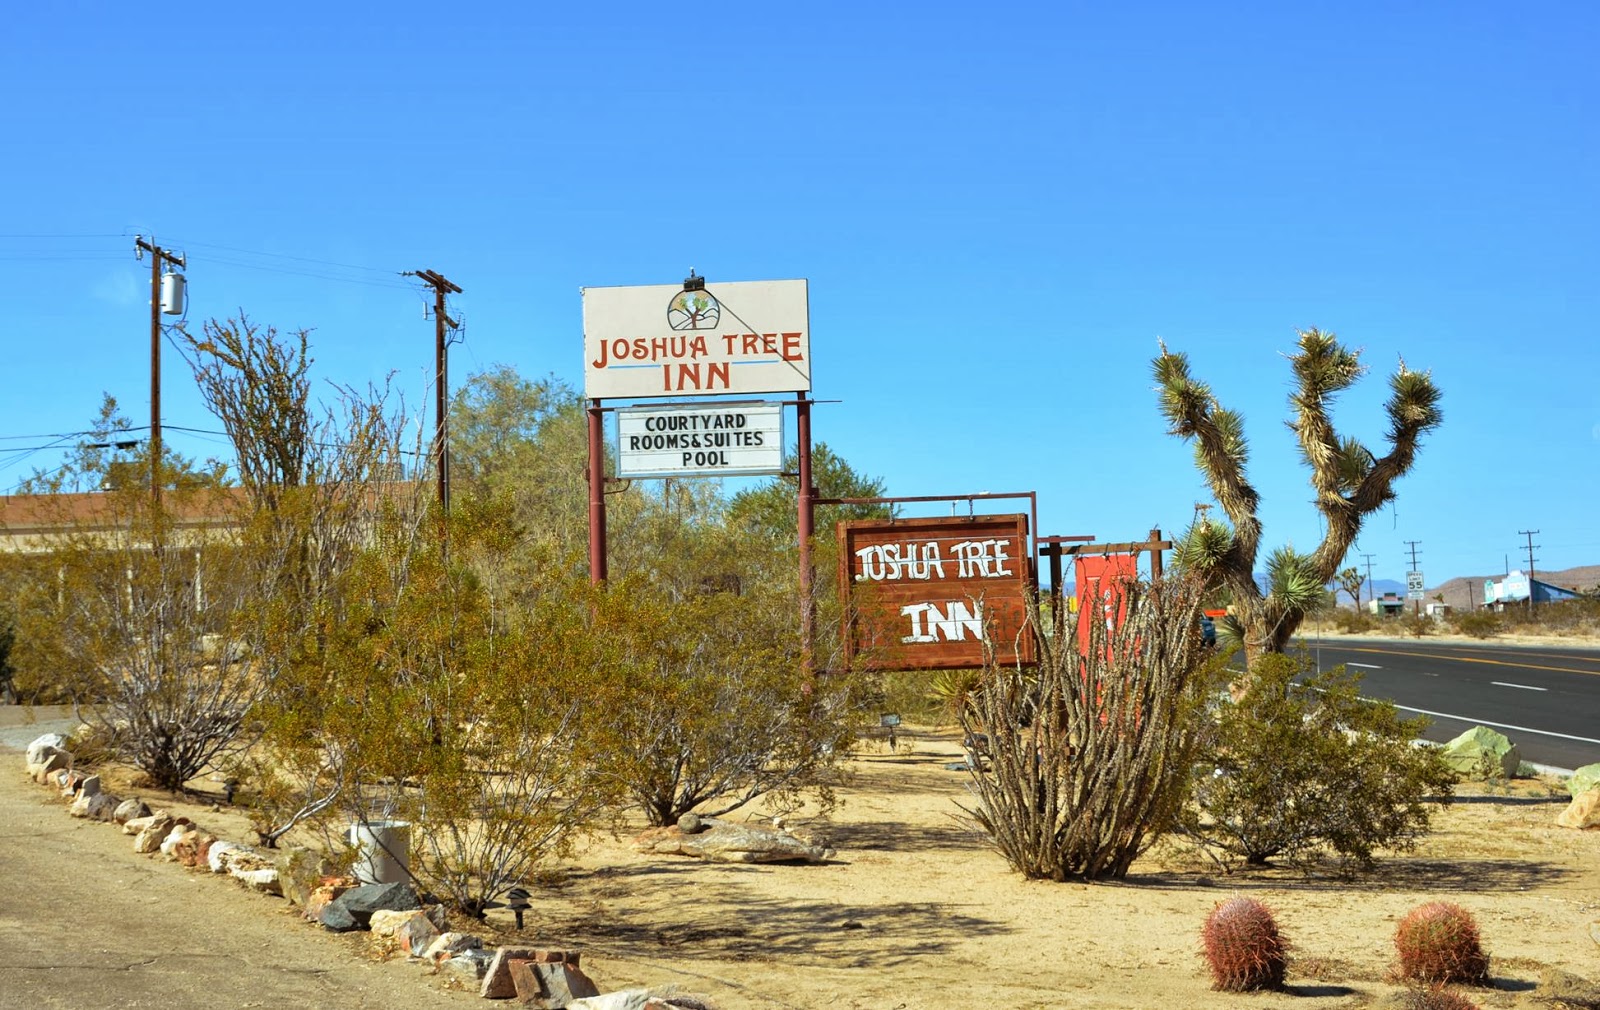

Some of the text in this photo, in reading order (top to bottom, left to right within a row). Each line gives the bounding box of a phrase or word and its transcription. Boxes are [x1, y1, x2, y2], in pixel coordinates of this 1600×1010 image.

[592, 332, 803, 369] JOSHUA TREE
[663, 362, 730, 391] INN
[645, 413, 746, 431] COURTYARD
[682, 451, 729, 466] POOL
[854, 539, 1013, 581] JOSHUA TREE
[1408, 581, 1422, 589] 55
[900, 601, 984, 644] INN
